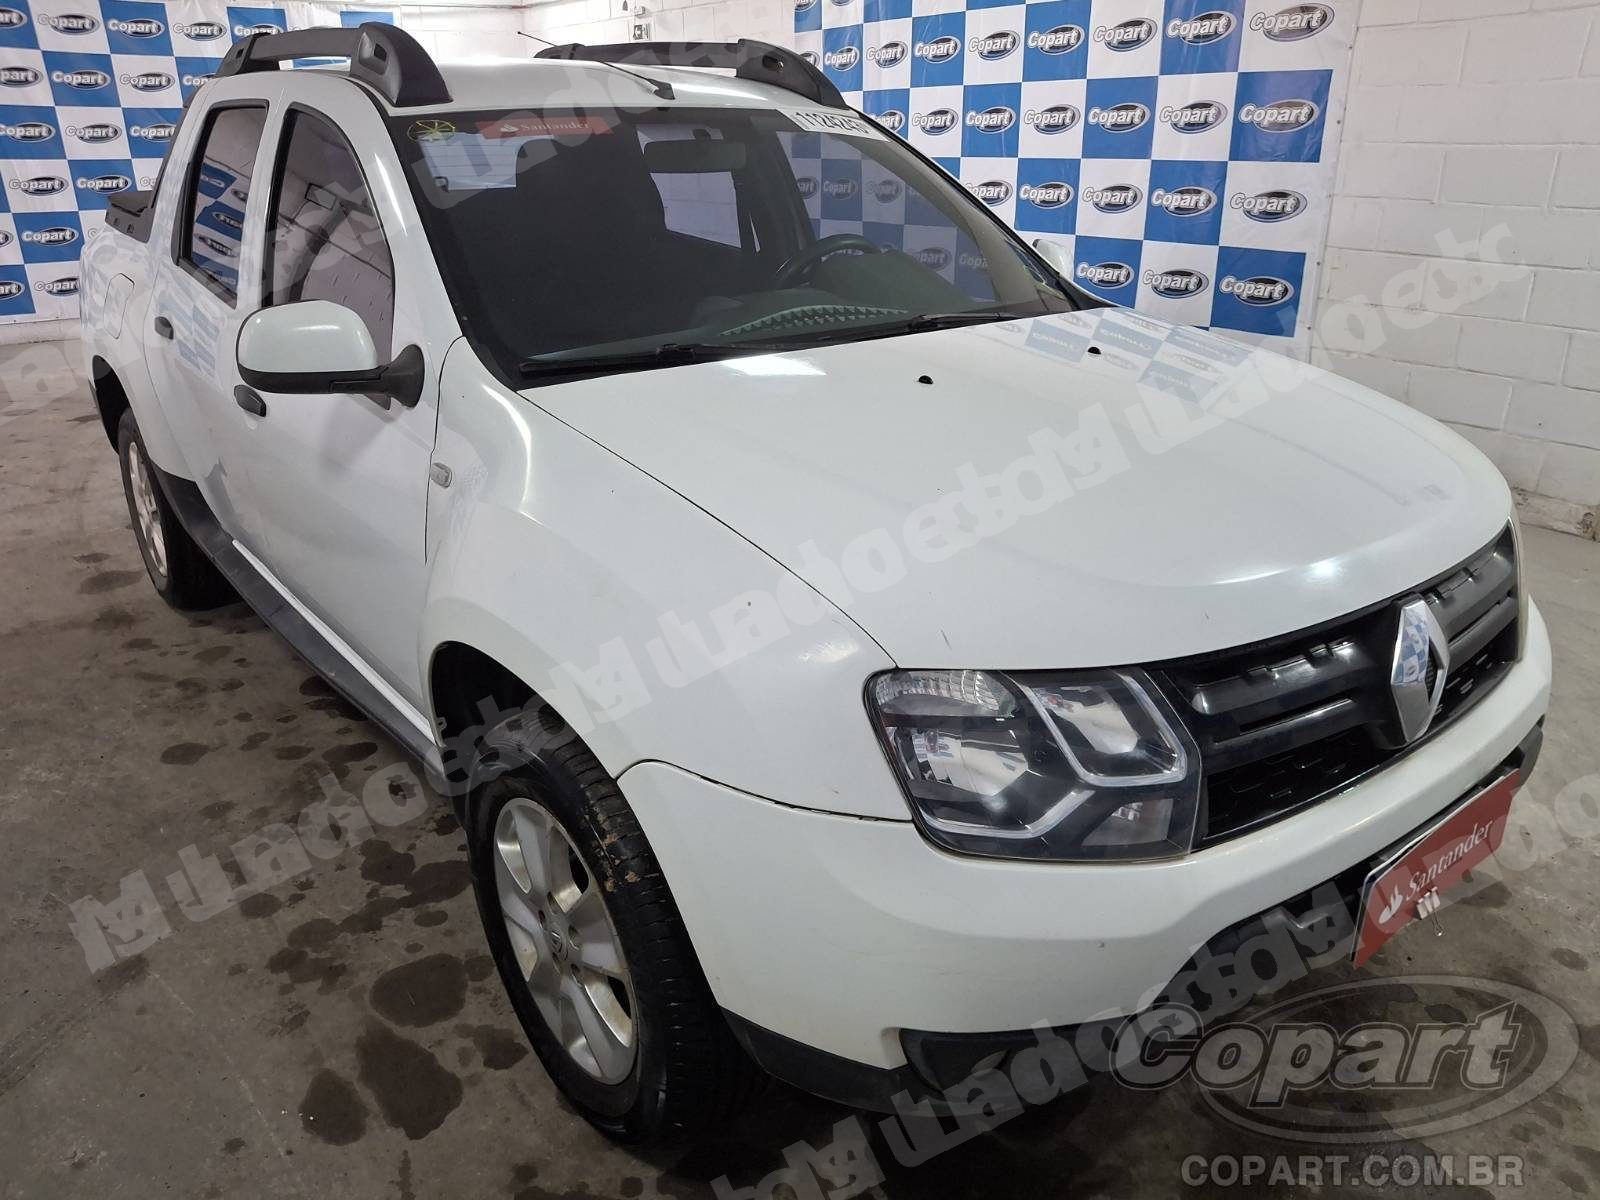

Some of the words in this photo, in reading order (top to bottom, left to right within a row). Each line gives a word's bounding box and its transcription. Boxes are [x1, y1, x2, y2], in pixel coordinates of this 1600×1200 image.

[37, 13, 91, 29] Copart
[107, 19, 158, 33] Copart
[1168, 13, 1227, 39] Copart
[1250, 7, 1328, 32] Copart
[173, 23, 220, 37] Copart
[1028, 27, 1080, 49] Copart
[1093, 20, 1147, 45] Copart
[915, 40, 956, 58] Copart
[969, 32, 1015, 54] Copart
[825, 51, 856, 66] Copart
[866, 46, 902, 63] Copart
[51, 70, 103, 85] Copart
[120, 73, 168, 88] Copart
[912, 111, 951, 131] Copart
[966, 109, 1010, 129] Copart
[1024, 107, 1074, 129] Copart
[1087, 107, 1142, 129] Copart
[1160, 105, 1218, 128] Copart
[1239, 103, 1315, 127] Copart
[65, 126, 115, 140] Copart
[519, 120, 590, 131] Santander
[9, 178, 61, 194] Copart
[75, 177, 125, 192] Copart
[1019, 185, 1067, 205] Copart
[1082, 186, 1135, 207] Copart
[1151, 188, 1206, 212] Copart
[1230, 192, 1296, 215] Copart
[21, 229, 72, 243] Copart
[1077, 263, 1128, 286] Copart
[1142, 269, 1199, 293] Copart
[34, 281, 80, 294] Copar
[1220, 277, 1285, 302] Copart
[1405, 820, 1493, 901] Santander
